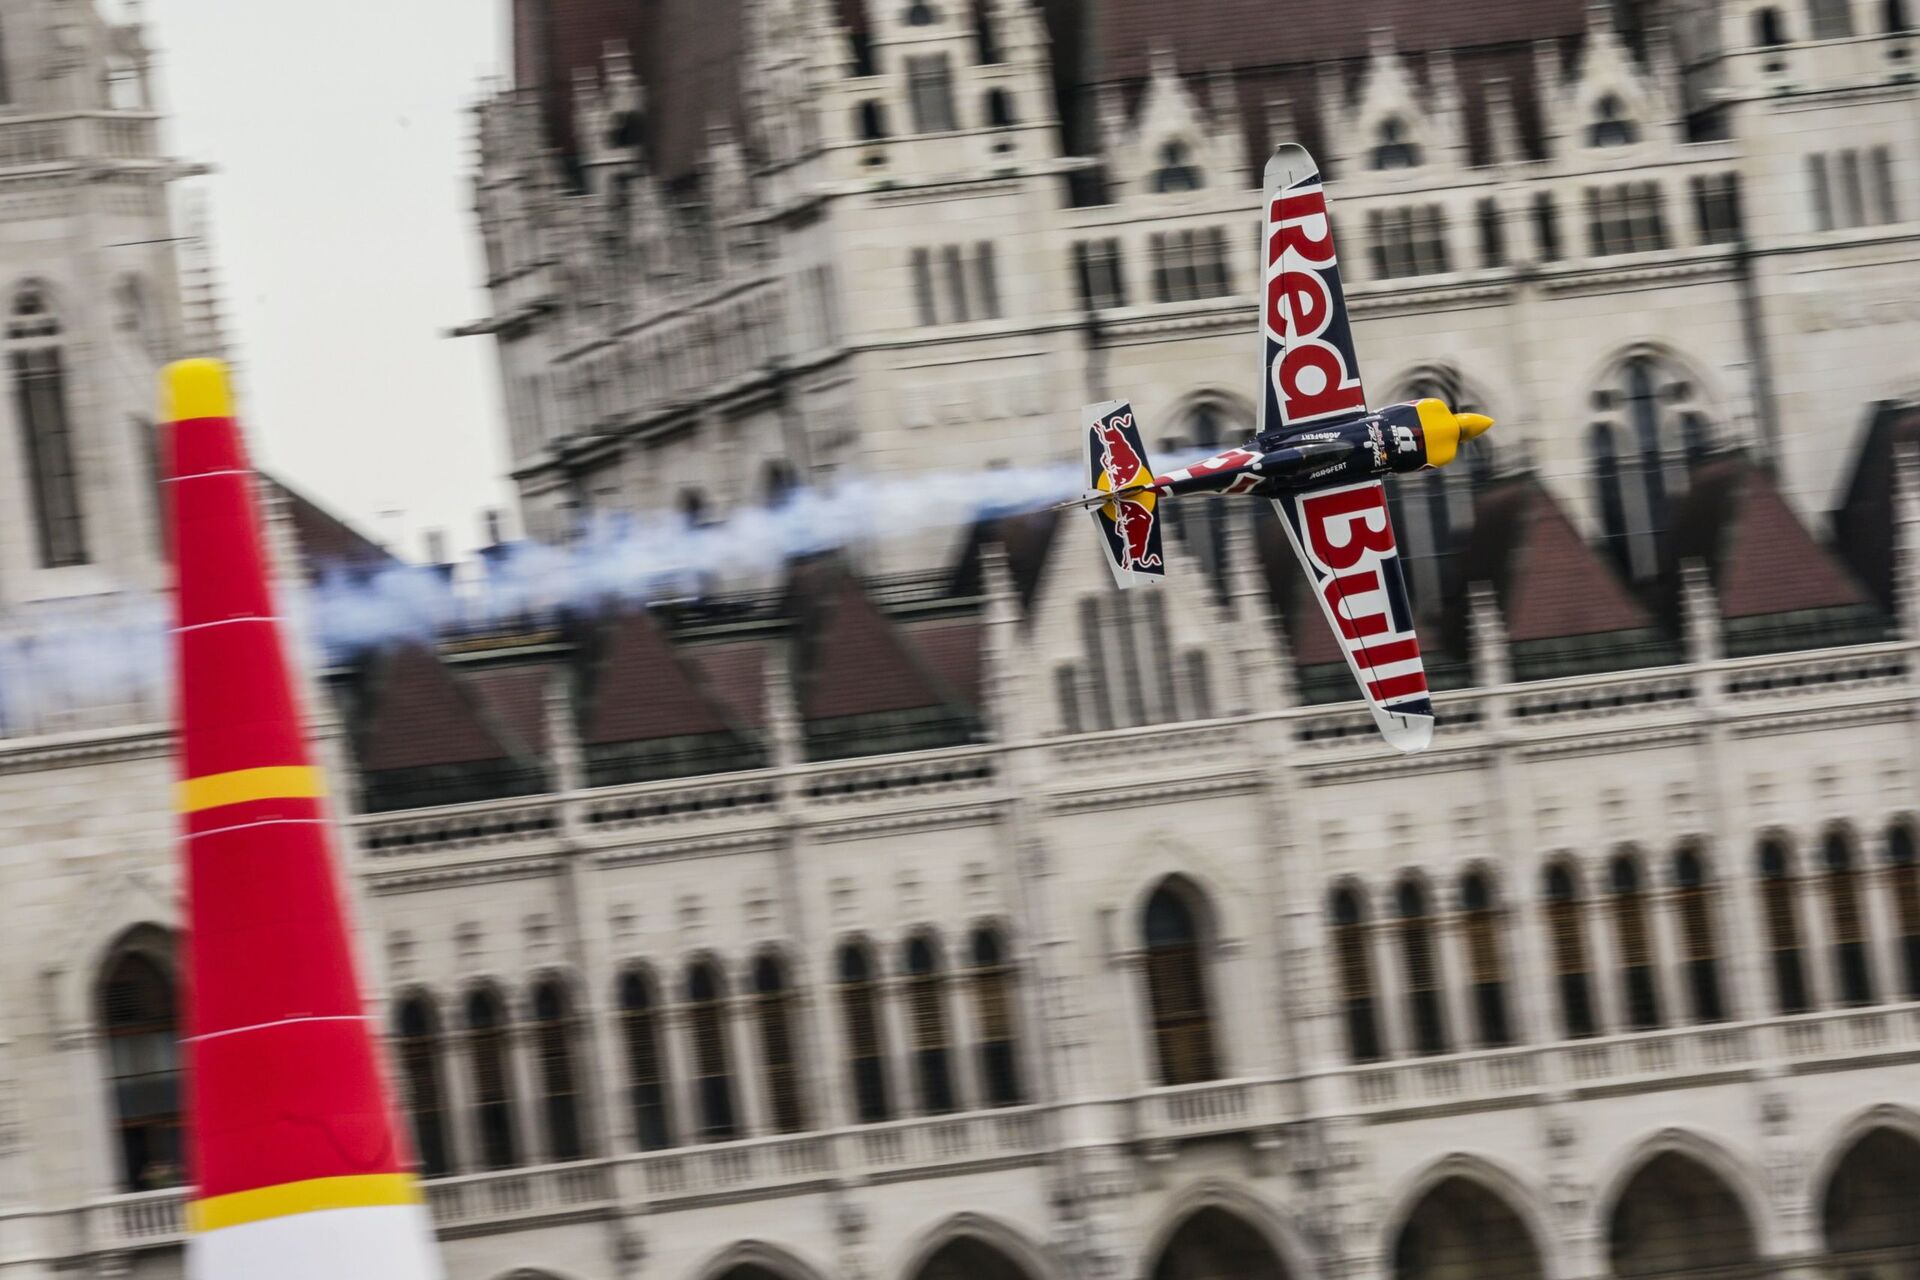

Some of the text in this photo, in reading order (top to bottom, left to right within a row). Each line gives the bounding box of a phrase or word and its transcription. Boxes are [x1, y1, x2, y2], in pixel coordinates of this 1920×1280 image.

[1301, 431, 1341, 440] AGROFERT
[1267, 190, 1429, 703] Red Bull
[1309, 461, 1347, 480] AGROFERT
